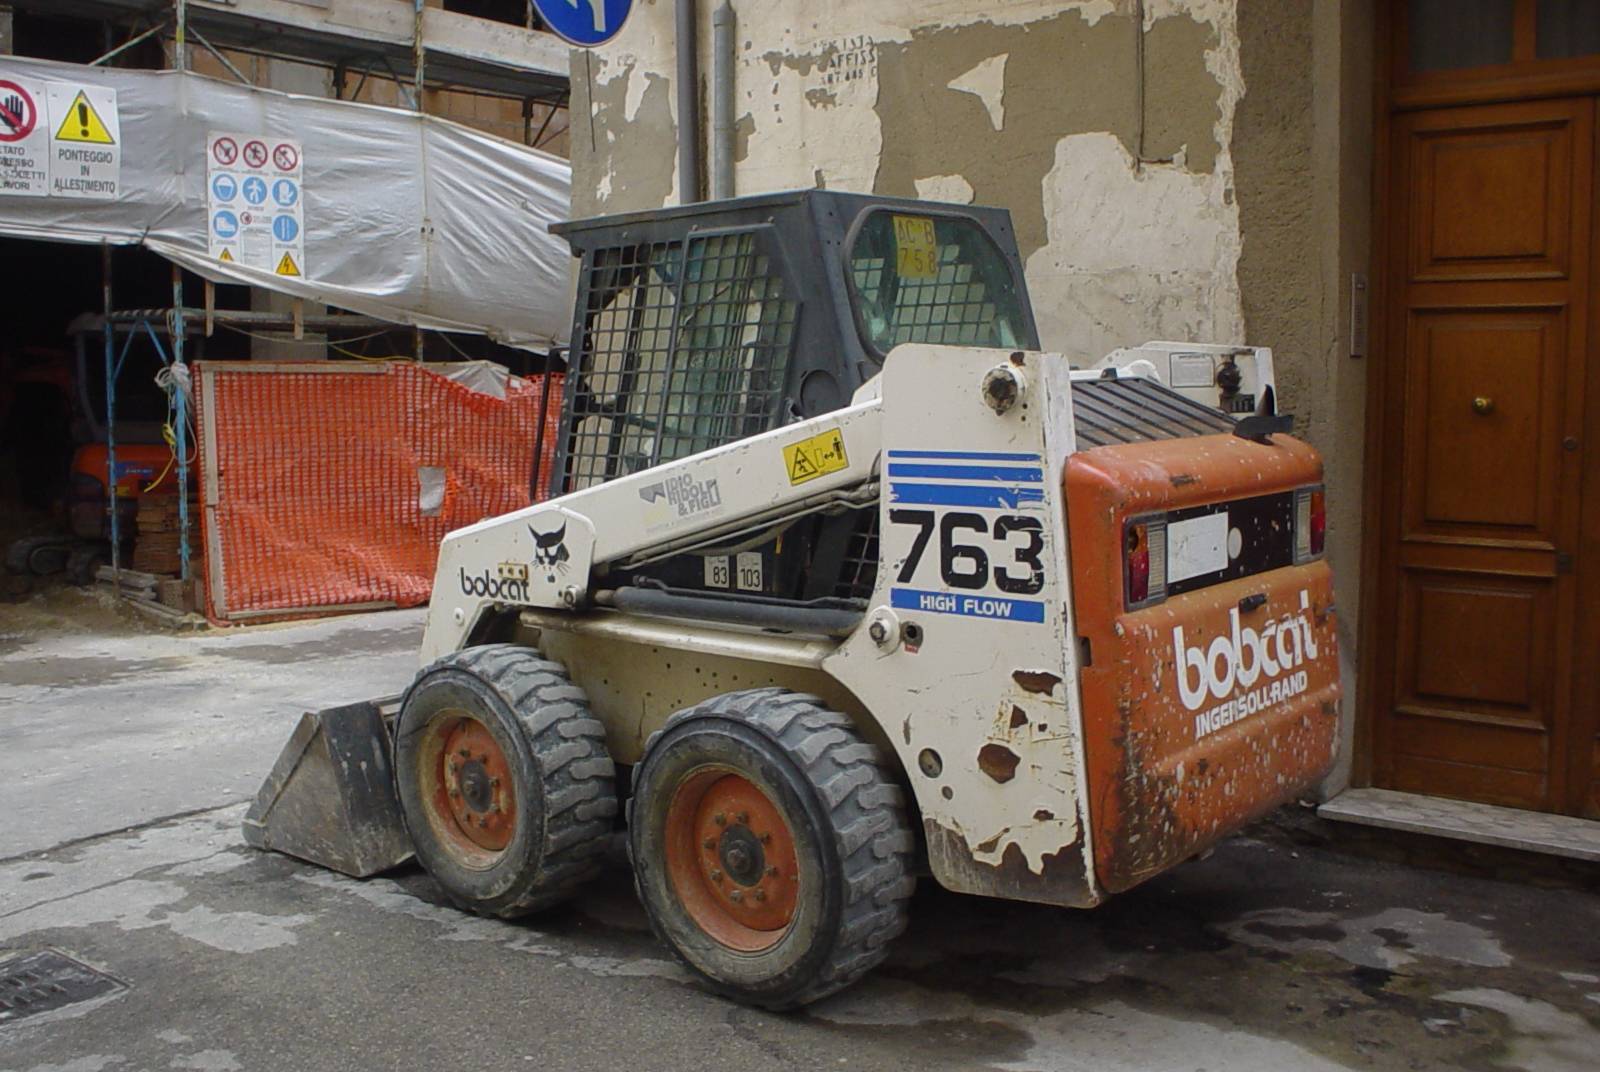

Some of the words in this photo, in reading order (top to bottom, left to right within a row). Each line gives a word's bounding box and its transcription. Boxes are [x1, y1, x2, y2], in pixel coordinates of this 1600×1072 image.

[58, 148, 113, 164] PONTEGGIO
[80, 165, 90, 176] IN
[54, 178, 116, 194] ALLESTIMENTO
[888, 508, 1045, 595] 763
[460, 566, 530, 602] bobcat
[713, 566, 728, 584] 83
[740, 568, 760, 587] 103
[920, 595, 956, 612] HIGH
[963, 598, 1012, 617] FLOW
[1173, 590, 1318, 711] bobcat
